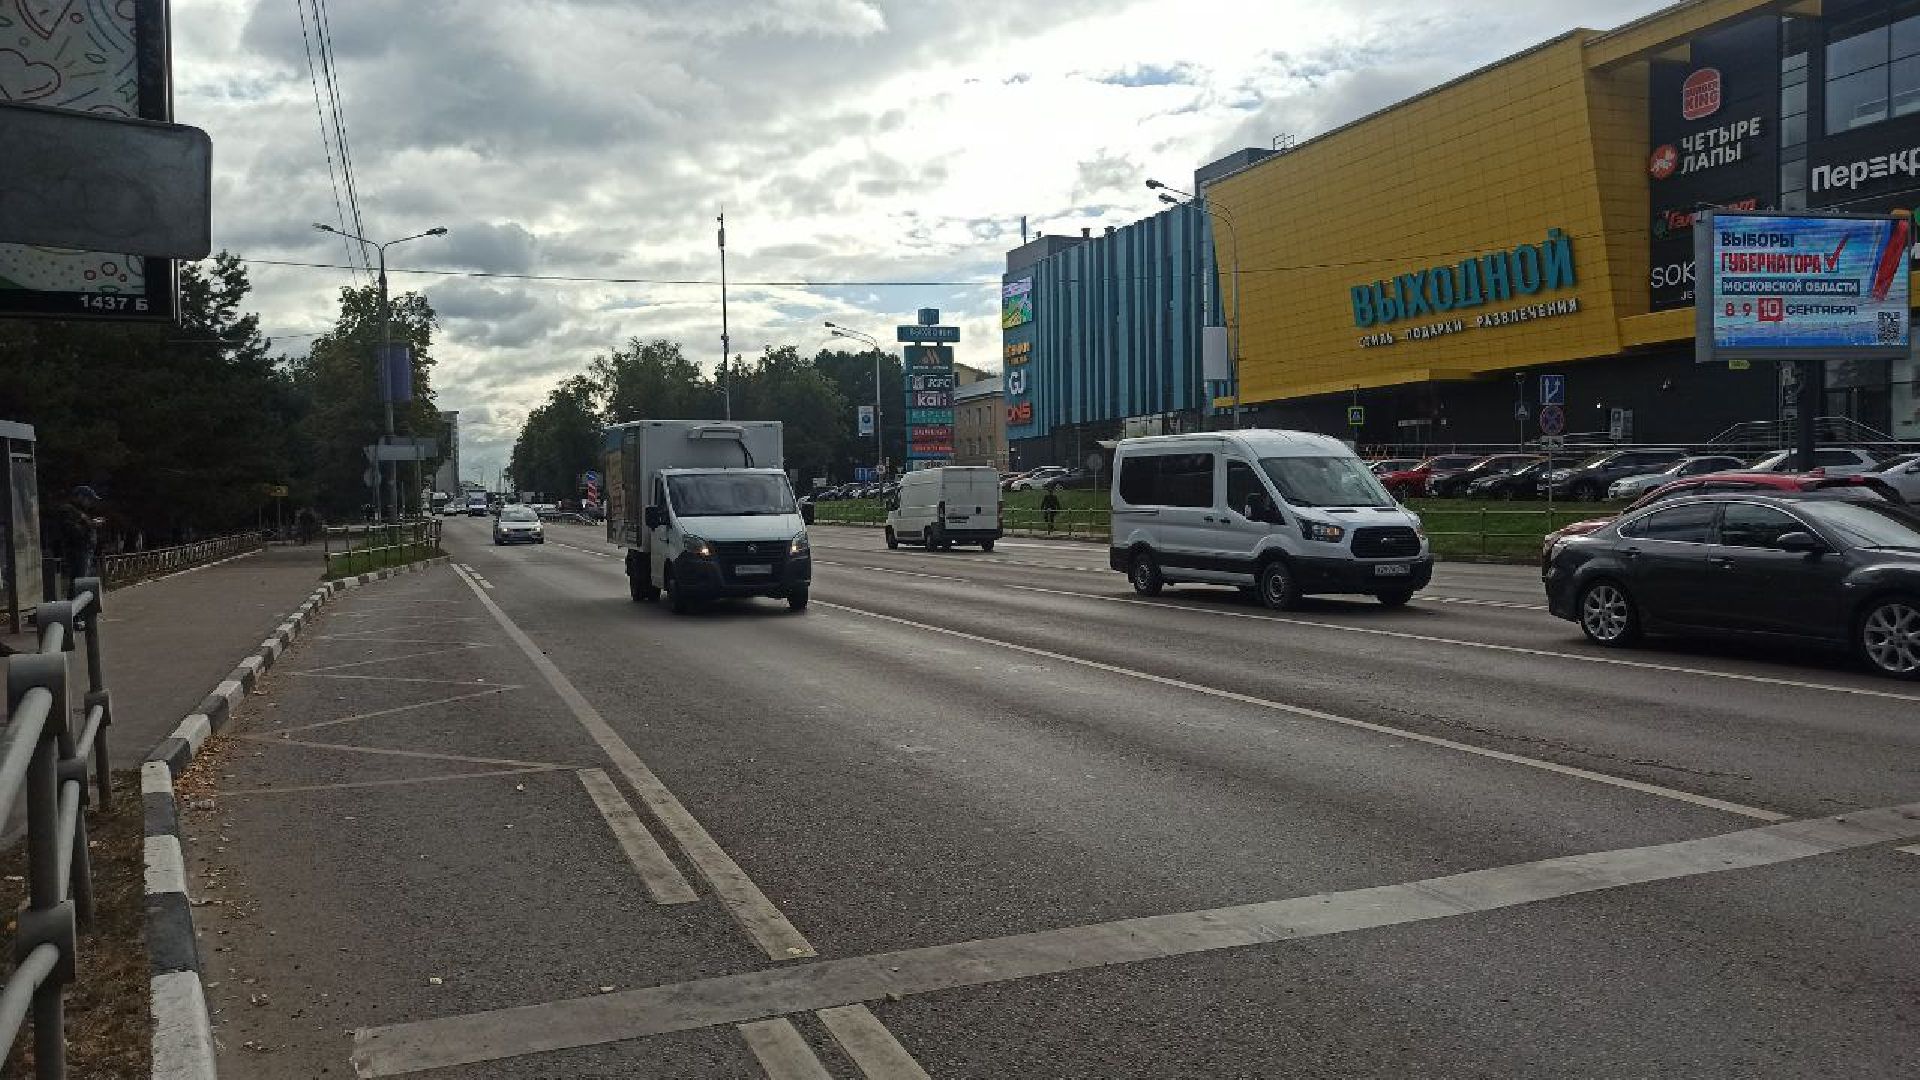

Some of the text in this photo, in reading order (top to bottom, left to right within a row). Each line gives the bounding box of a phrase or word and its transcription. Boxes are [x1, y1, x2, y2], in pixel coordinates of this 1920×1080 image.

[1684, 91, 1719, 111] KING
[1682, 117, 1761, 152] ЧЕТЫРЕ
[1680, 142, 1741, 175] ЛАПЫ
[1721, 231, 1795, 247] ВЫБОРЫ
[1721, 252, 1822, 274] ГУБЕРНАТОРА
[1350, 228, 1574, 328] ВЫХОДНОЙ
[1722, 279, 1858, 293] МОСКОВСКОЙ ОБЛАСТИ
[80, 294, 129, 310] 1437
[1725, 300, 1857, 317] 8 9 10 СЕНТЯБРЯ
[1359, 298, 1579, 348] СТИЛЬ ПОДАРКИ РАЗВЛЕЧЕНИЯ
